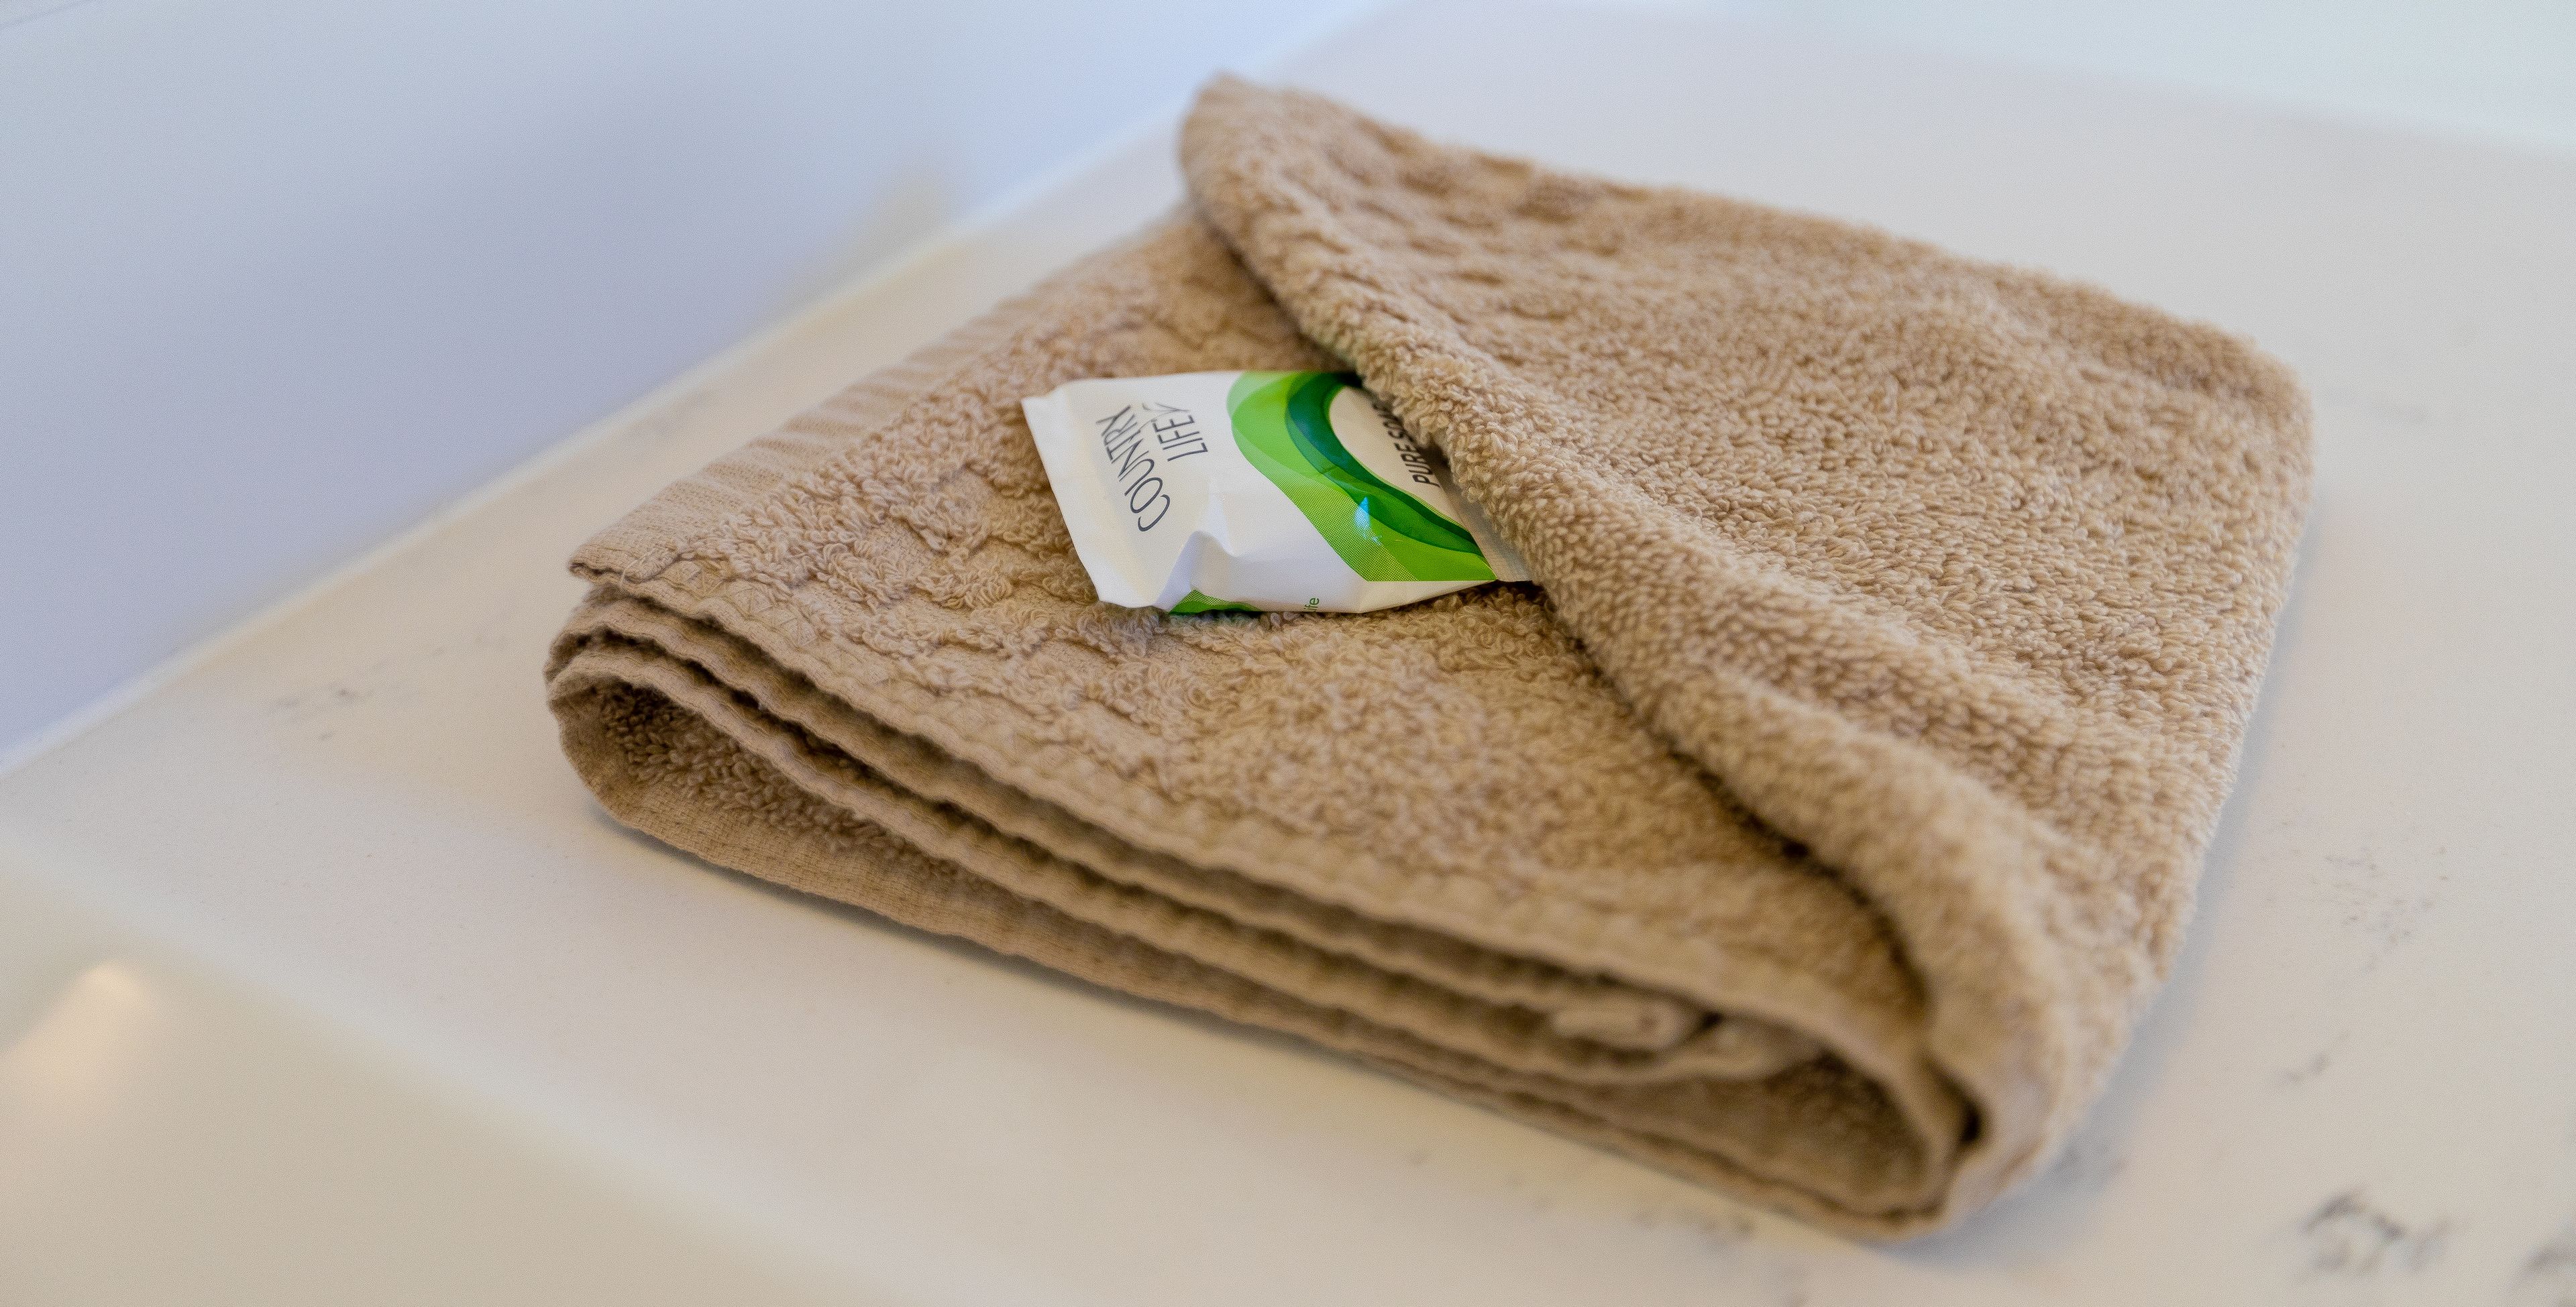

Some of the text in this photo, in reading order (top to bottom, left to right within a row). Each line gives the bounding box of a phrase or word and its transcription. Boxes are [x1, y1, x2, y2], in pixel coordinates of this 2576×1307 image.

[1152, 414, 1208, 462] LIFE
[1095, 405, 1170, 532] COUNTRY
[1393, 442, 1440, 488] PURE
